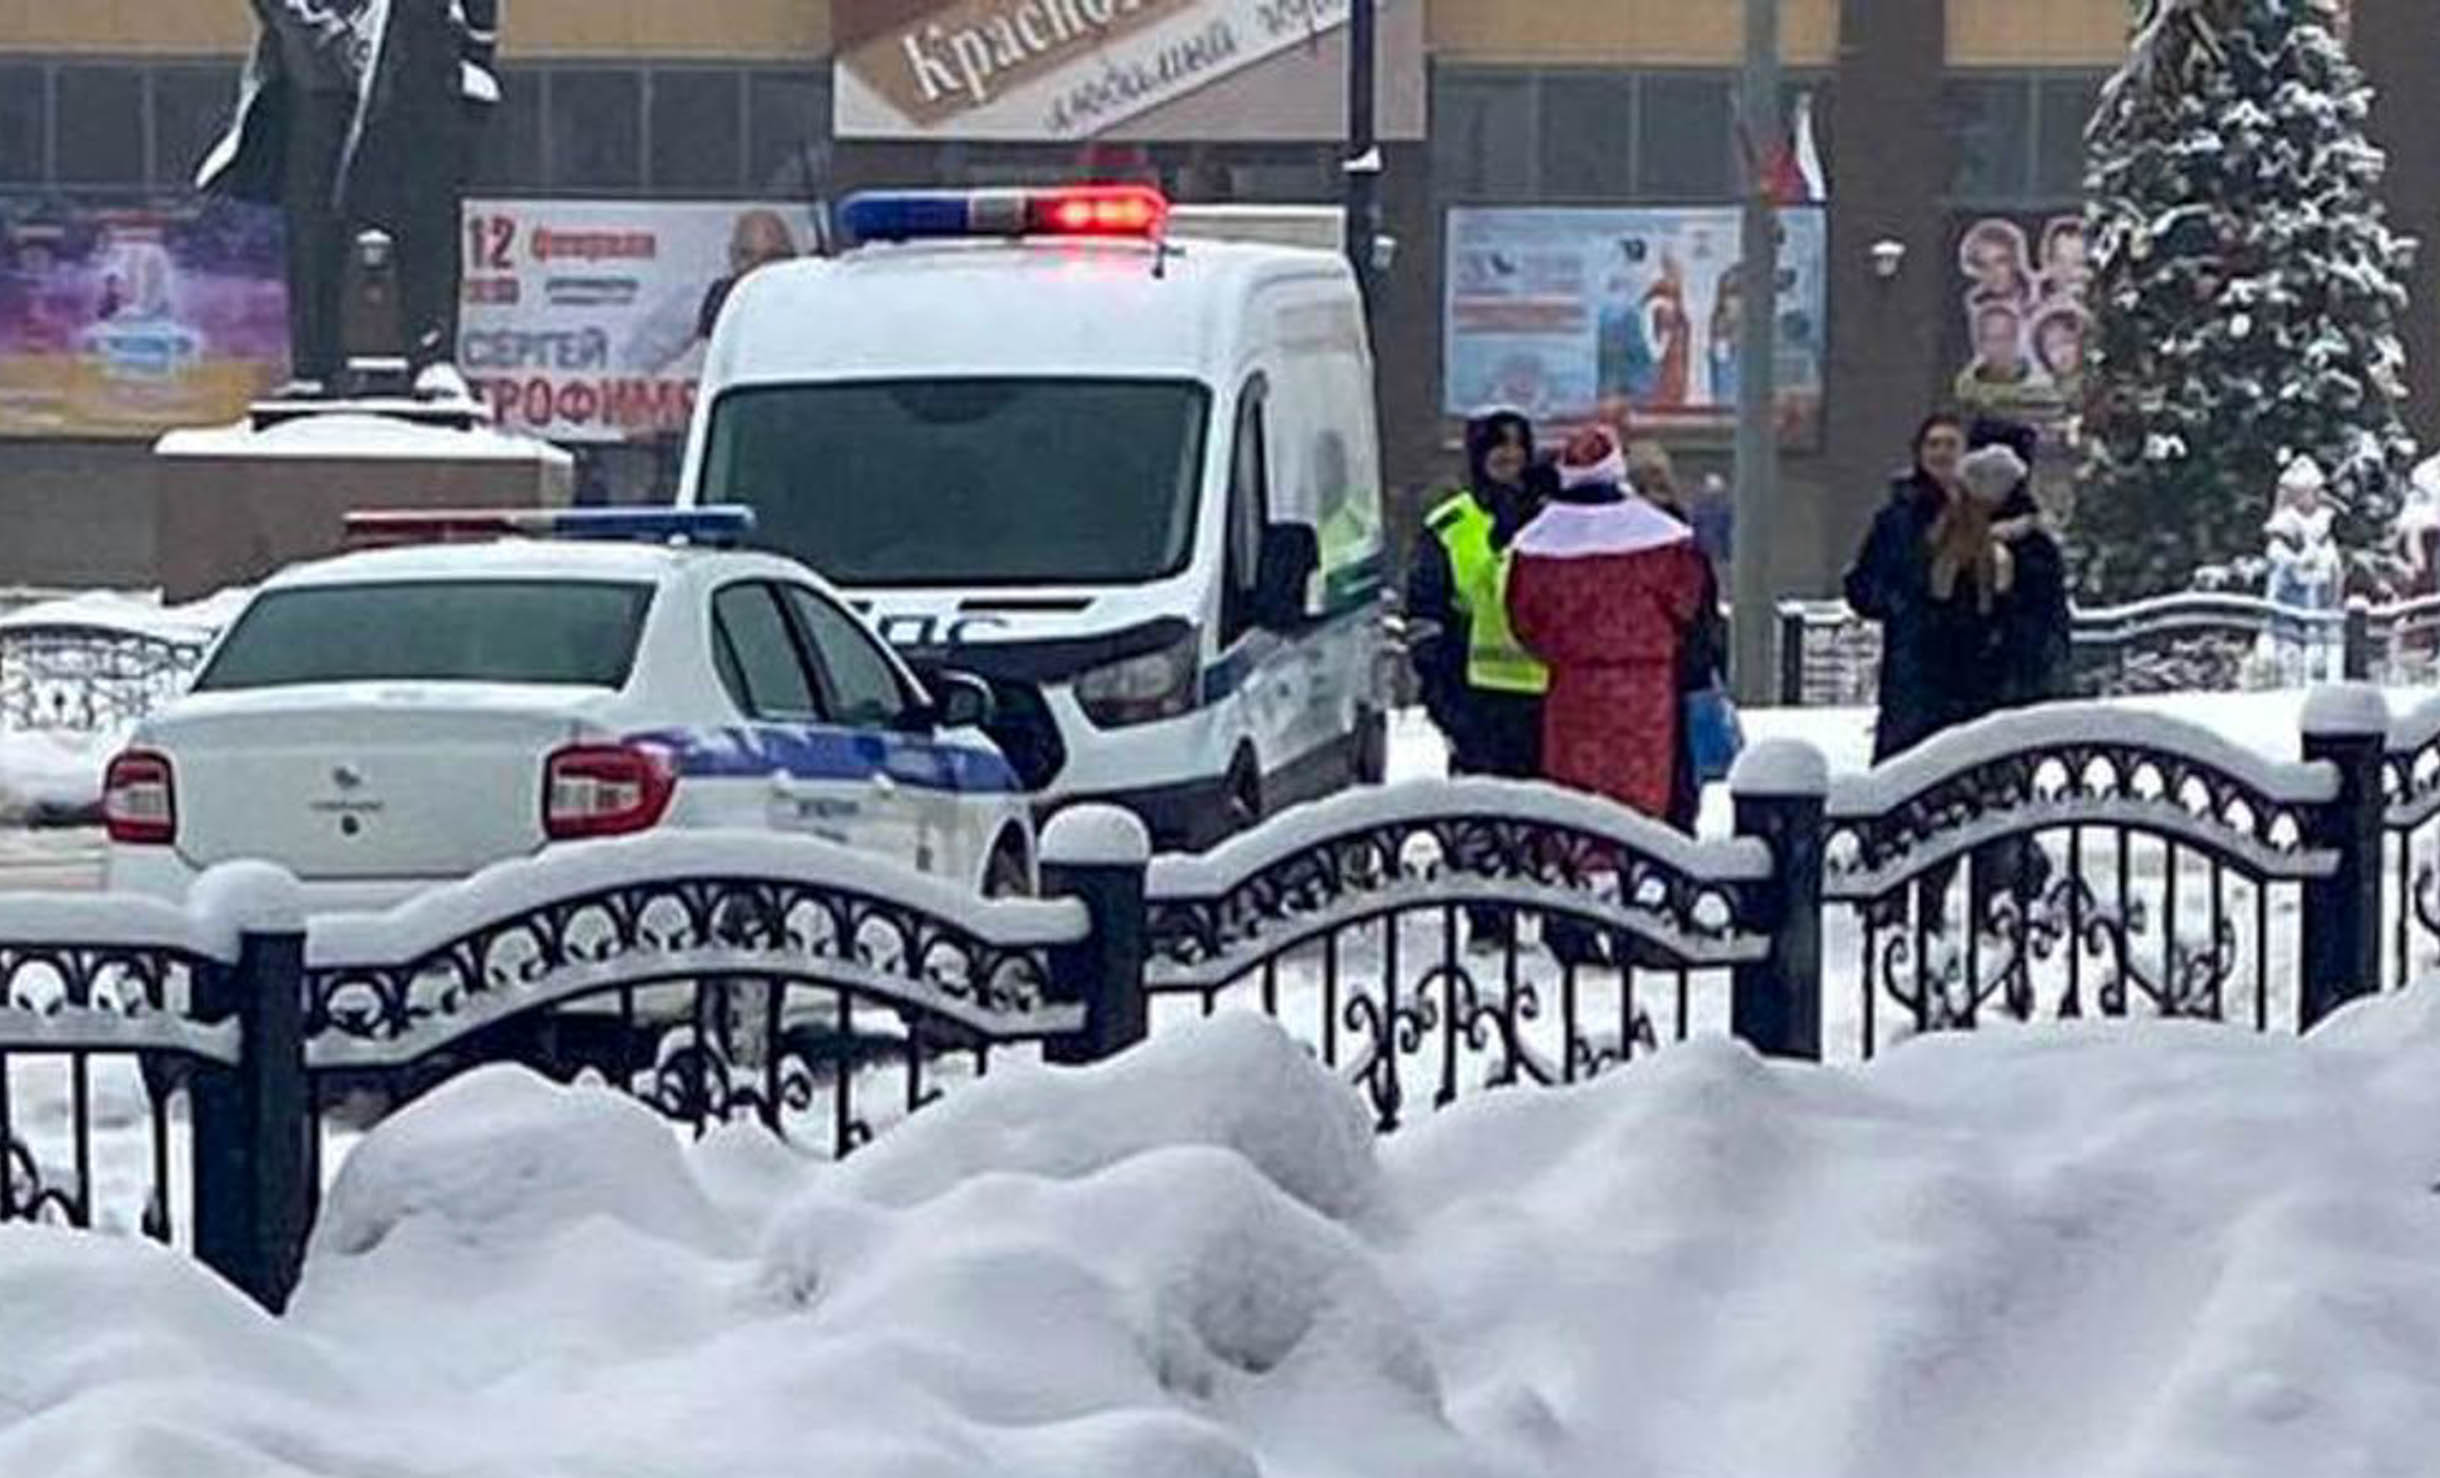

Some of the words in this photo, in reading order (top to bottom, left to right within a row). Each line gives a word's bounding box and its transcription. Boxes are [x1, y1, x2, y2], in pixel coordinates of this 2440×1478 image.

[903, 0, 1139, 100] Красно
[469, 216, 516, 269] 12
[462, 327, 609, 370] СЕРГЕЙ
[876, 614, 1009, 648] ПС
